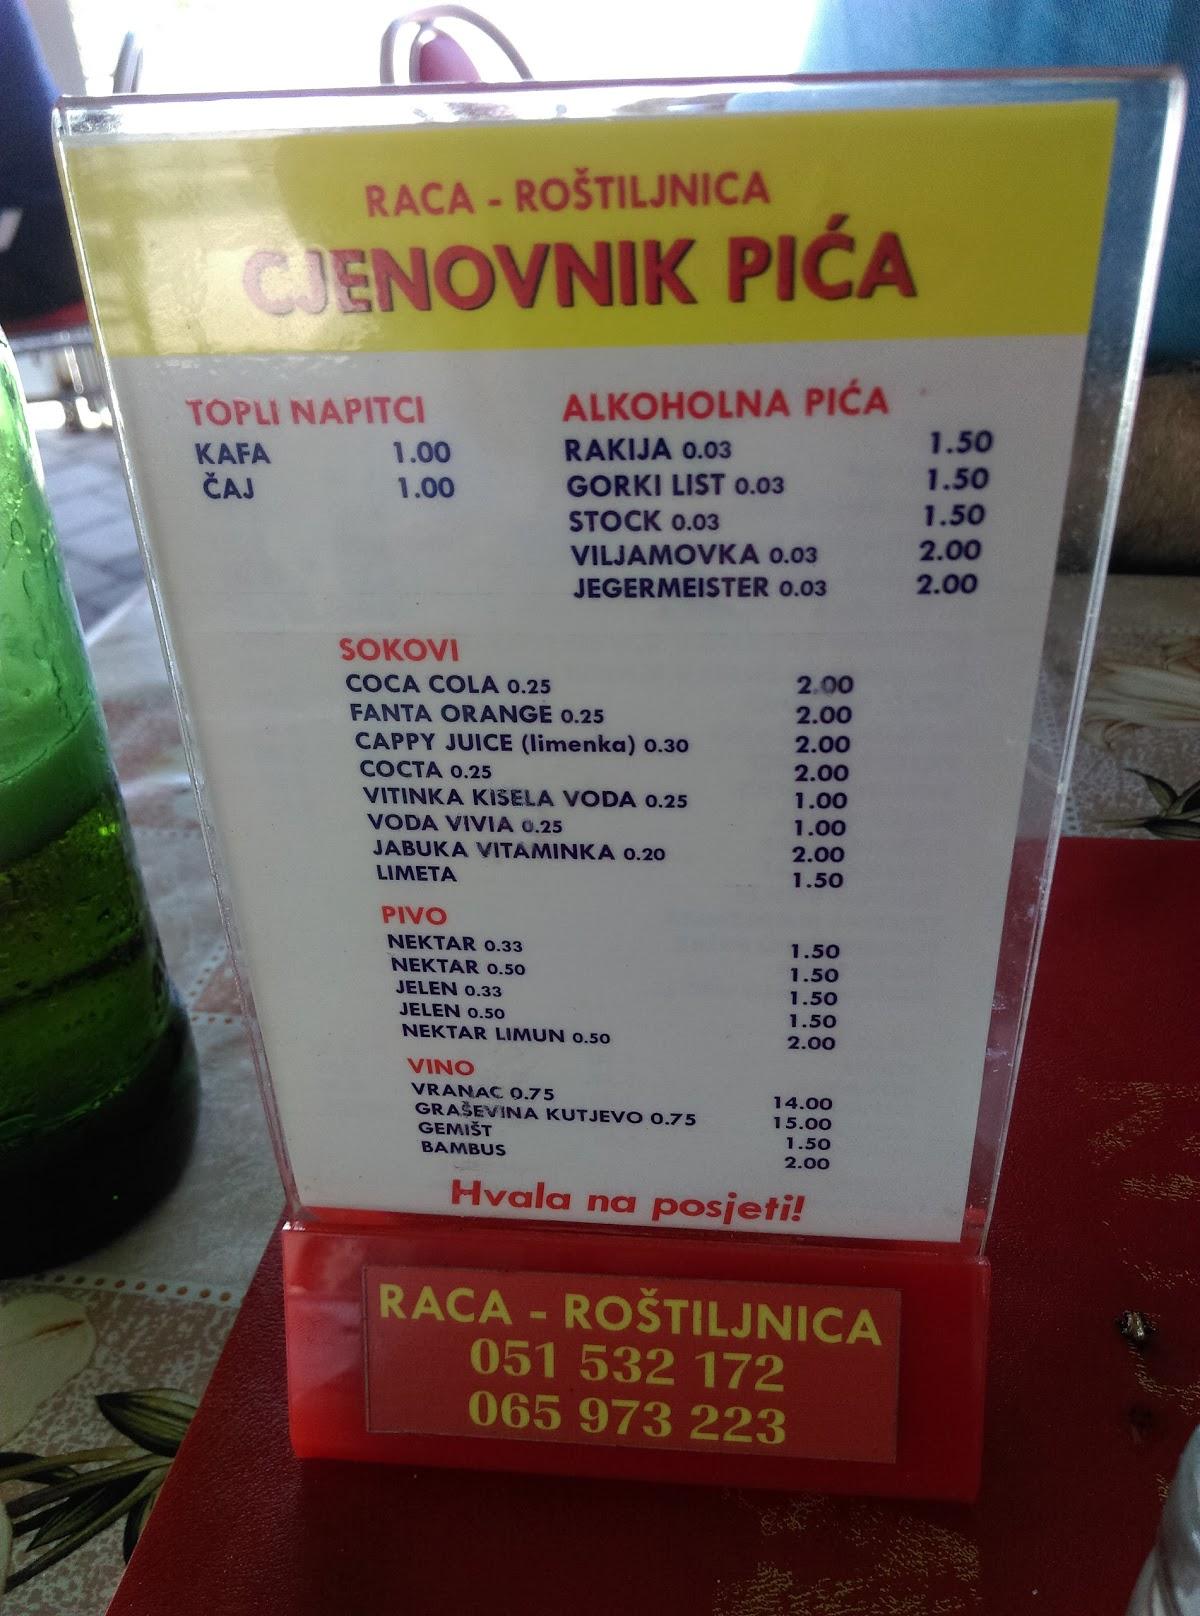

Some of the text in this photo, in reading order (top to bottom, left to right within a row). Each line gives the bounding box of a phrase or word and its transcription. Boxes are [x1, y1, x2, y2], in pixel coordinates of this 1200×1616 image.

[365, 167, 770, 218] RACA - ROŠTILJNICA
[243, 213, 917, 315] CJENOVNIK PIĆA
[186, 395, 424, 426] TOPLI NAPITCI
[562, 378, 889, 422] ALKOHOLNA PIĆA
[393, 441, 451, 463] 1.00
[565, 438, 732, 461] RAKIJA 0.03
[930, 430, 993, 454] 1.50
[195, 442, 271, 465] KAFA
[203, 472, 254, 499] ČAJ
[398, 477, 455, 499] 1.00
[567, 473, 784, 497] GORKI LIST 0.03
[927, 468, 989, 490] 1.50
[569, 510, 720, 532] STOCK 0.03
[925, 504, 985, 526] 1.50
[571, 543, 817, 566] VILJAMOVKA 0.03
[919, 539, 981, 561] 2.00
[574, 577, 826, 599] JEGERMEISTER 0.03
[916, 573, 978, 595] 2.00
[339, 638, 459, 662] SOKOVI
[346, 674, 551, 694] COCA COLA 0.25
[797, 675, 853, 694] 2.00
[350, 703, 604, 724] FANTA ORANGE 0.25
[796, 706, 852, 724] 2.00
[355, 732, 689, 756] CAPPY JUICE (limenka) 0.30
[795, 735, 850, 753] 2.00
[360, 760, 492, 779] COCTA 0.25
[795, 764, 849, 782] 2.00
[363, 787, 687, 808] VITINKA KISELA VODA 0.25
[795, 792, 847, 809] 1.00
[367, 813, 562, 834] VODA VIVIA 0.25
[795, 820, 846, 836] 1.00
[373, 840, 665, 861] JABUKA VITAMINKA 0.20
[792, 847, 844, 863] 2.00
[376, 864, 457, 882] LIMETA
[793, 872, 843, 888] 1.50
[381, 906, 447, 925] PIVO
[387, 934, 522, 952] NEKTAR 0.33
[790, 944, 840, 960] 1.50
[391, 957, 526, 976] NEKTAR 0.50
[790, 967, 839, 983] 1.50
[396, 980, 502, 997] JELEN 0.33
[790, 991, 837, 1006] 1.50
[400, 1002, 505, 1020] JELEN 0.50
[789, 1013, 837, 1028] 1.50
[402, 1024, 610, 1045] NEKTAR LIMUN 0.50
[787, 1036, 836, 1051] 2.00
[407, 1058, 475, 1076] VINO
[412, 1082, 555, 1101] VRANAC 0.75
[415, 1101, 696, 1127] GRAŠEVINA KUTJEVO 0.75
[773, 1096, 833, 1111] 14.00
[419, 1121, 492, 1137] GEMIŠT
[773, 1117, 832, 1131] 15.00
[422, 1141, 506, 1157] BAMBUS
[785, 1137, 831, 1151] 1.50
[784, 1156, 830, 1170] 2.00
[451, 1179, 805, 1225] Hvala na posjeti!
[379, 1283, 883, 1347] RACA - ROŠTILJNICA
[470, 1338, 784, 1392] 051 532 172
[468, 1390, 786, 1444] 065 973 223
